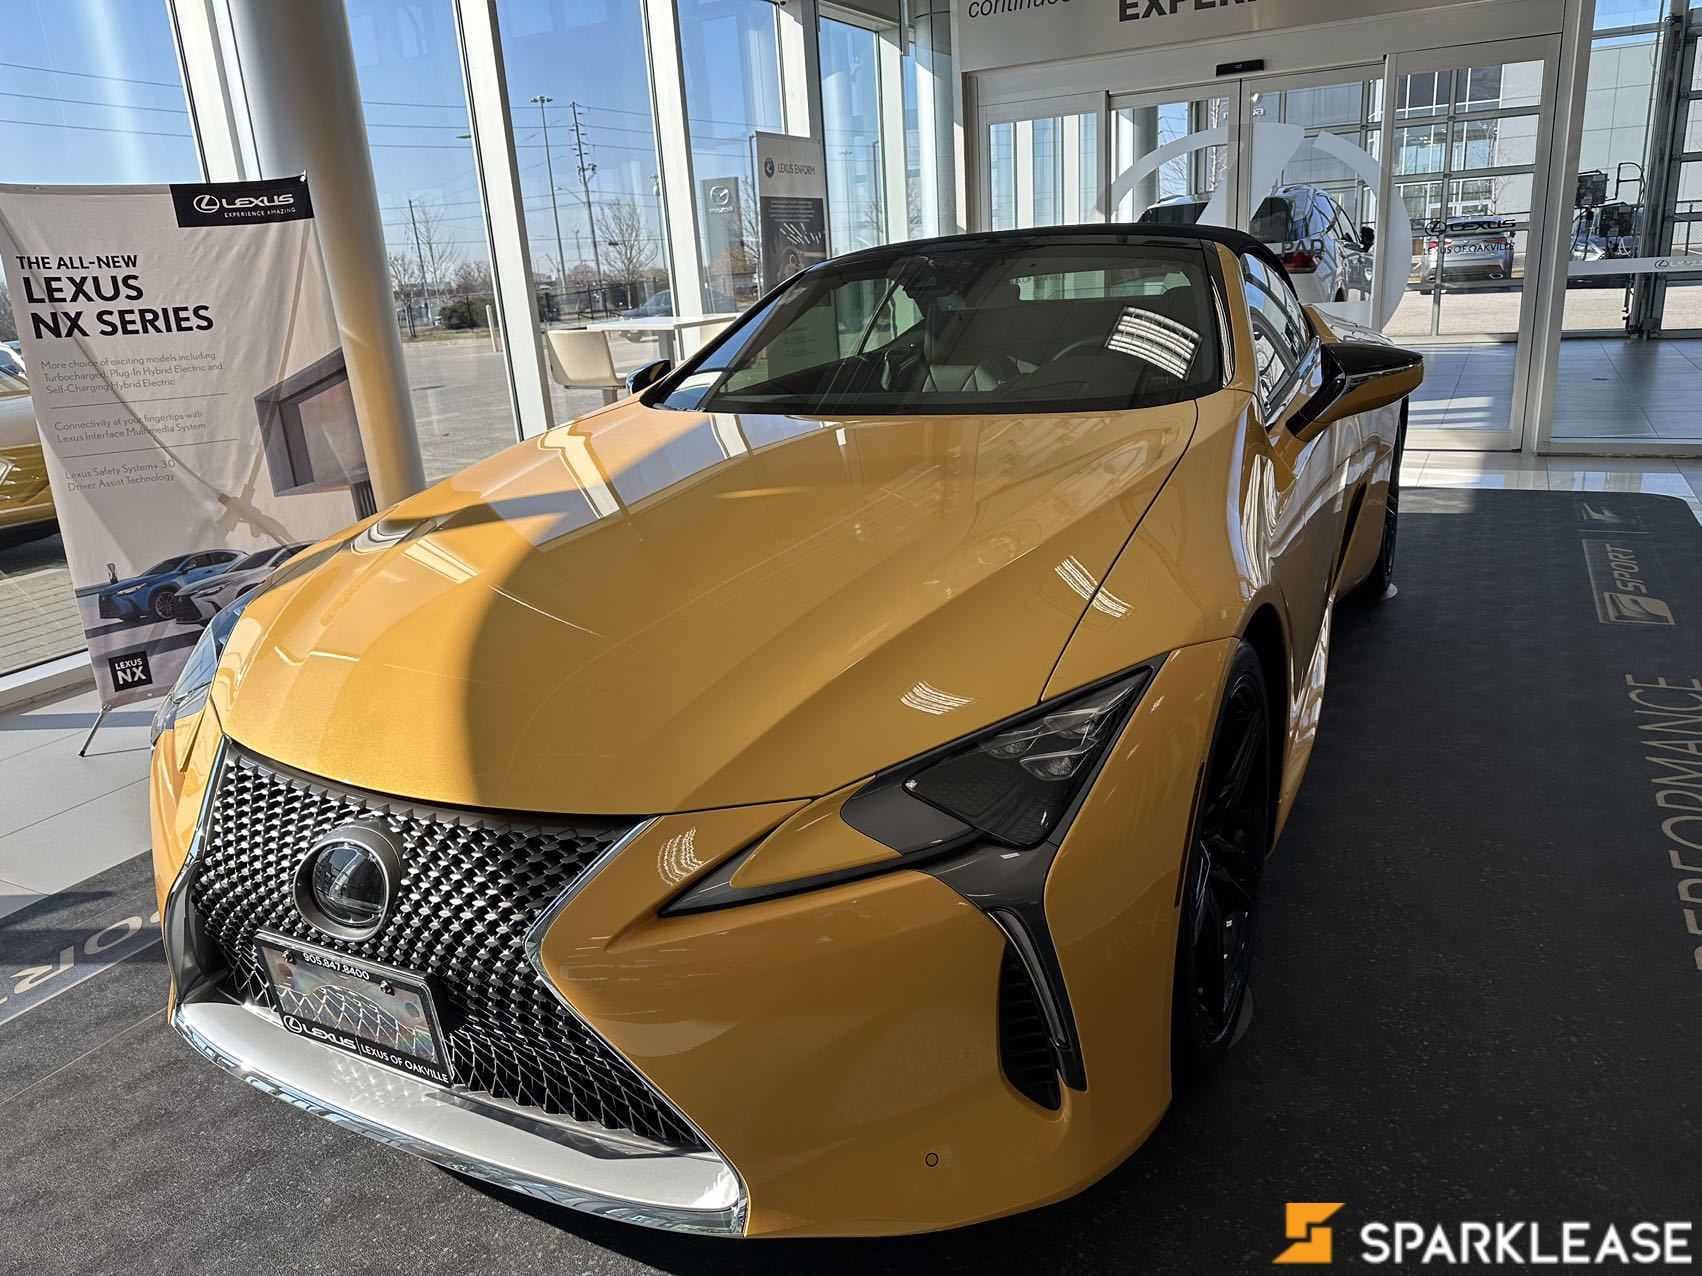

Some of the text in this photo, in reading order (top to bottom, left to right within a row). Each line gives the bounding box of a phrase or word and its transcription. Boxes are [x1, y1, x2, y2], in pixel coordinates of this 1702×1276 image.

[221, 194, 295, 209] LEXUS
[224, 209, 265, 218] EXPERIENCE
[15, 254, 139, 270] THE ALL-NEW
[22, 274, 145, 304] LEXUS
[29, 304, 215, 340] NX SERIES
[41, 360, 67, 370] More
[68, 359, 97, 368] choice
[99, 358, 109, 367] of
[110, 357, 144, 368] exciting
[146, 353, 176, 364] models
[143, 366, 171, 377] Hybrid
[56, 434, 84, 443] Lexus
[1605, 543, 1649, 594] SPORT
[114, 658, 143, 670] LEXUS
[117, 666, 147, 685] NX
[303, 952, 370, 980] 905.847.8400
[302, 1025, 449, 1083] LEXUS LEXUS OF OAKVILLE
